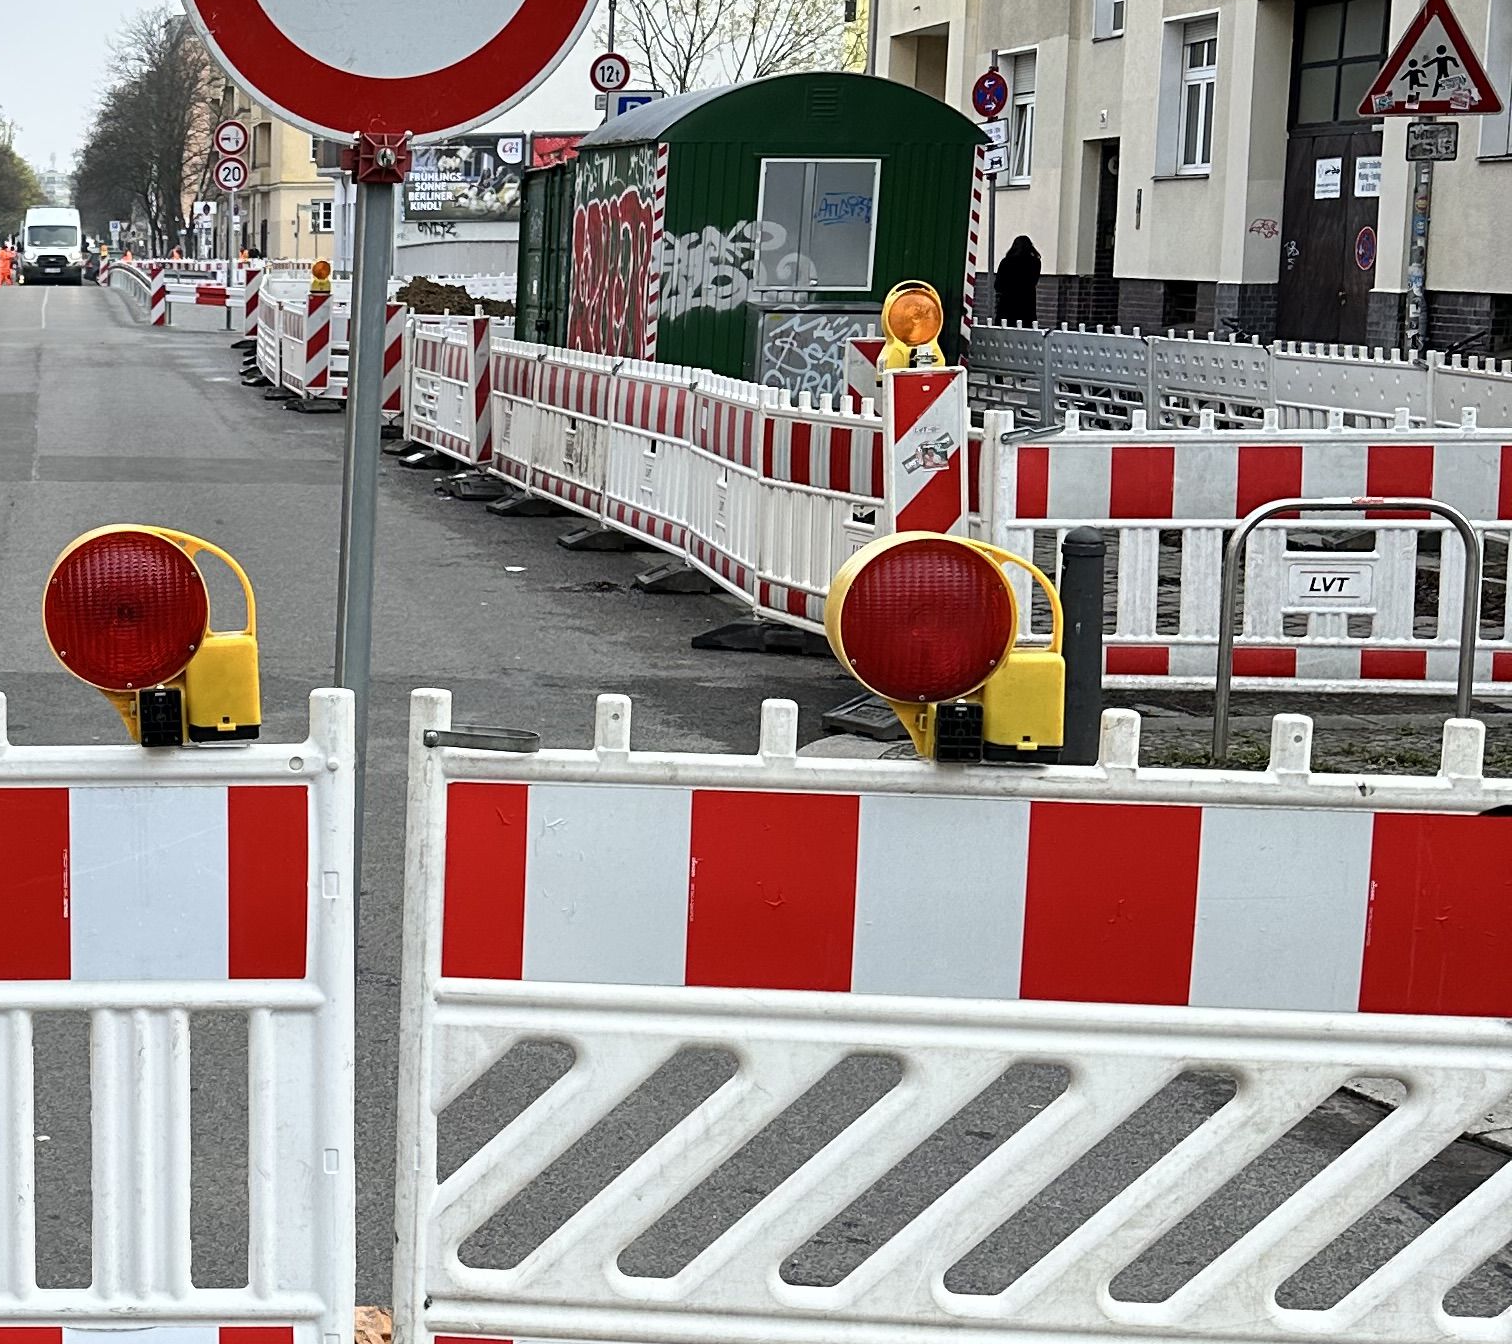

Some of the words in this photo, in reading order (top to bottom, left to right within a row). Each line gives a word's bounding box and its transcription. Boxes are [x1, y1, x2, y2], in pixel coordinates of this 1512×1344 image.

[222, 166, 241, 182] 20
[414, 182, 447, 191] SONNE
[409, 192, 453, 201] BERLINER
[410, 202, 442, 211] KINDL!
[1309, 577, 1350, 592] LVT
